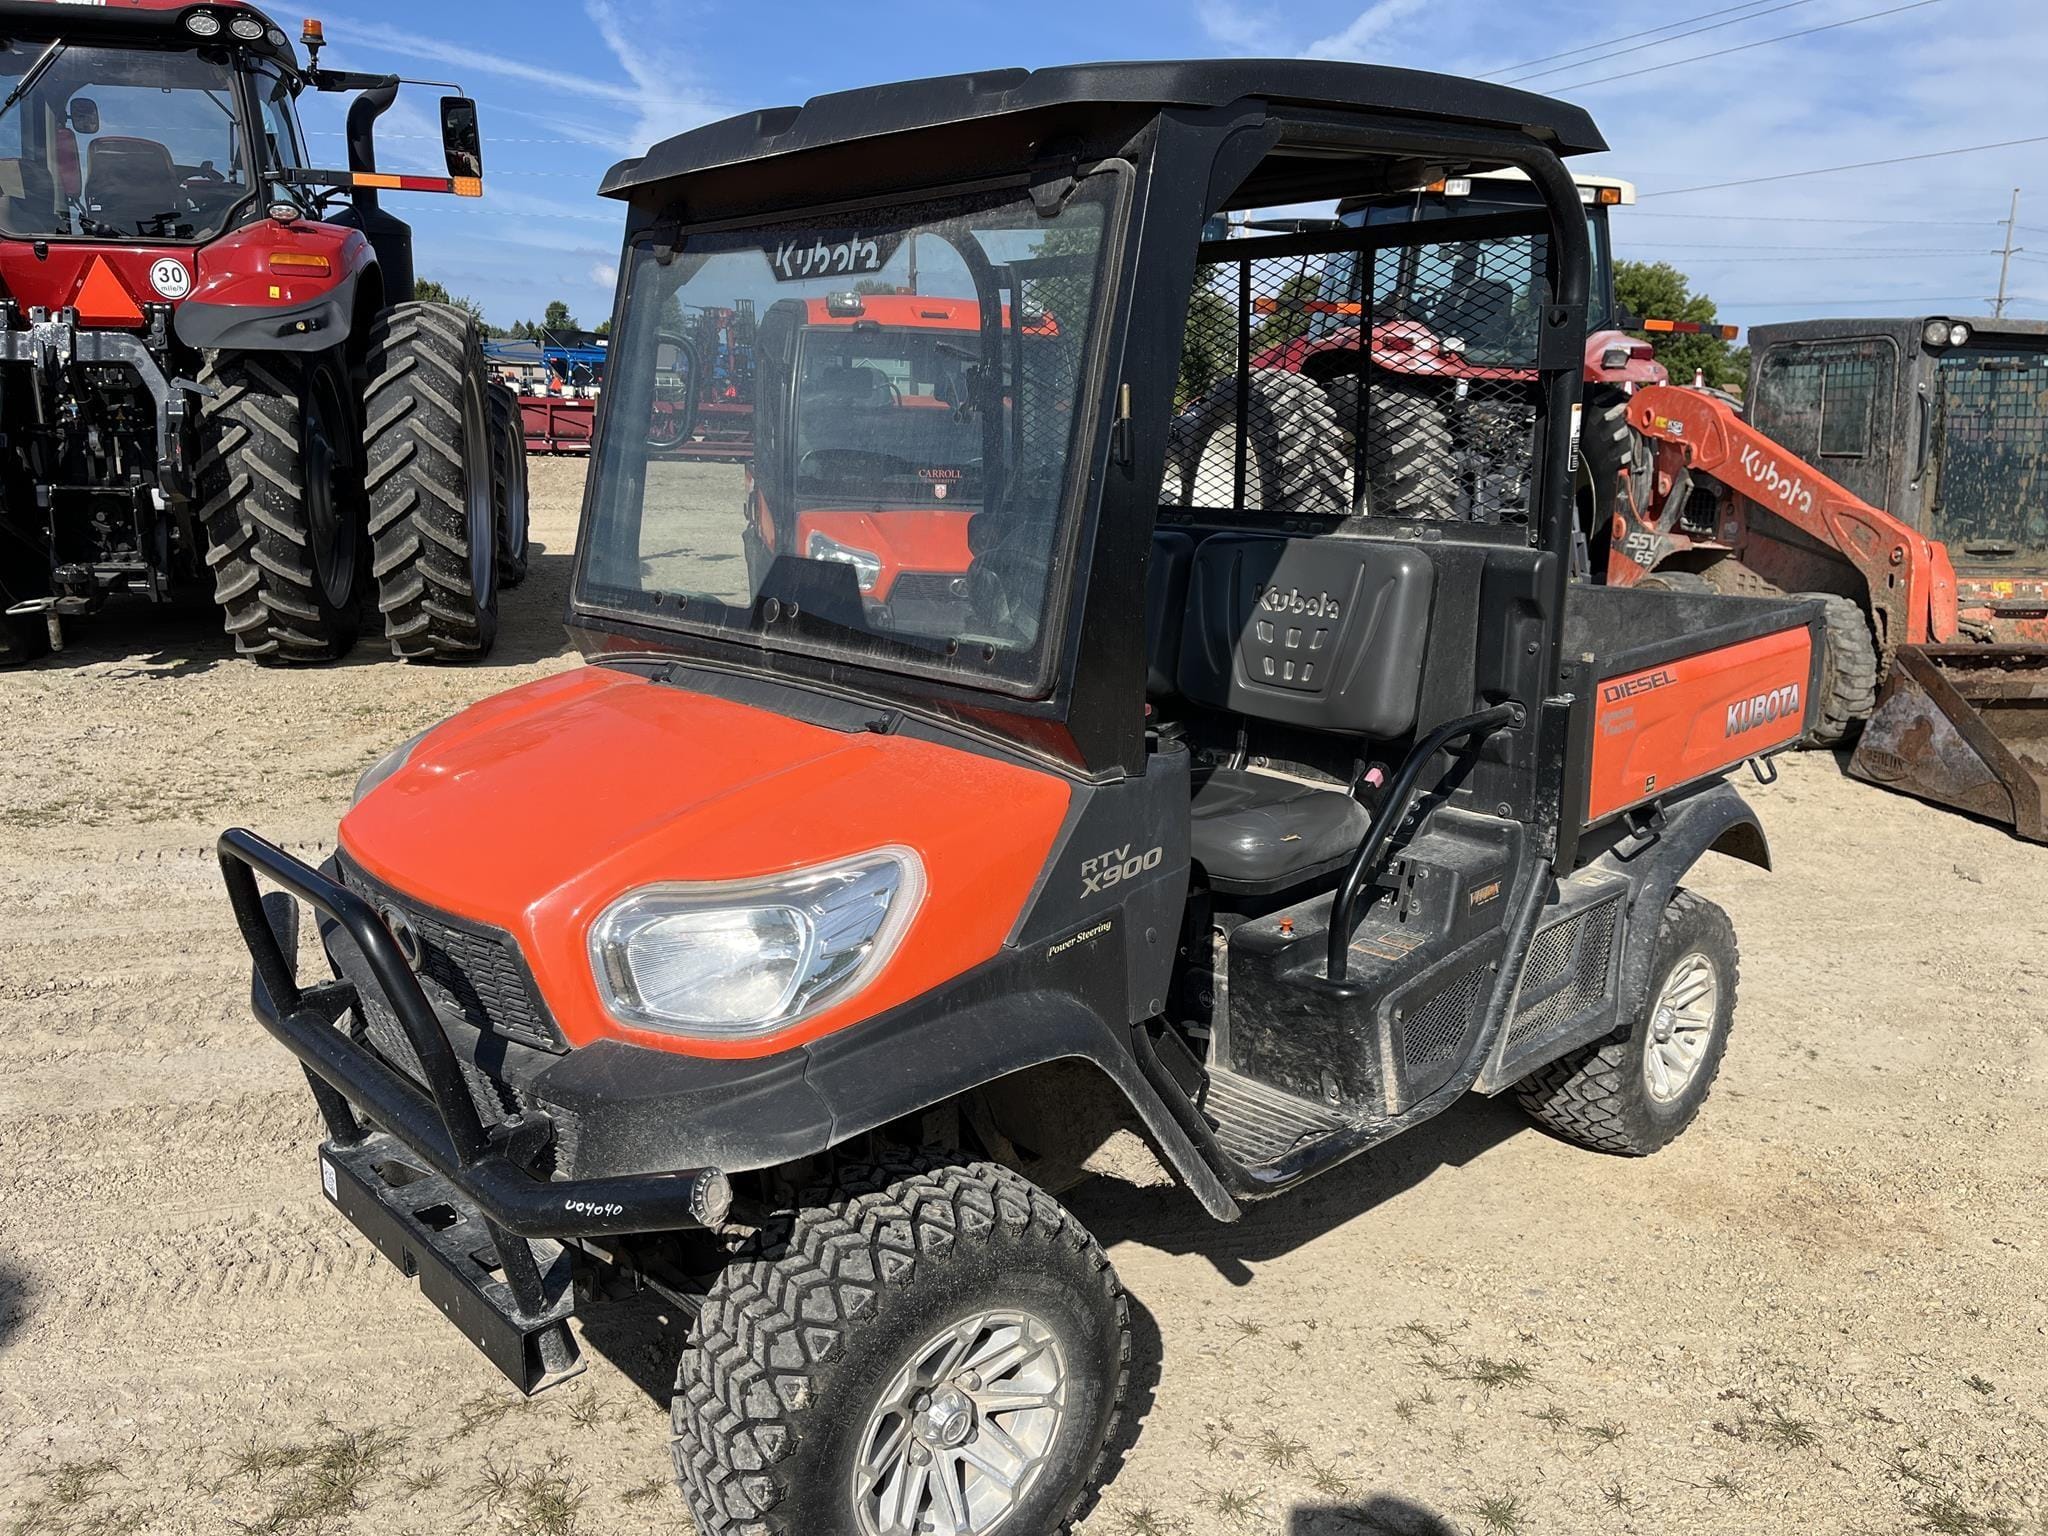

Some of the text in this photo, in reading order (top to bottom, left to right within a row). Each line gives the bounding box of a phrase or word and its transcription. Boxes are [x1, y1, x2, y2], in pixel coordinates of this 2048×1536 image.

[775, 232, 878, 277] Kubota
[158, 267, 182, 283] 30
[918, 469, 963, 479] CARROLL
[1740, 443, 1812, 514] Kubota
[1626, 532, 1663, 551] SSV
[1634, 550, 1655, 565] 65
[1253, 584, 1340, 619] Kubota
[1603, 670, 1678, 704] DIESEL
[1725, 682, 1799, 738] KUBOTA
[1080, 846, 1163, 899] X900
[1081, 843, 1130, 877] RTV
[1048, 921, 1112, 957] Power Steering
